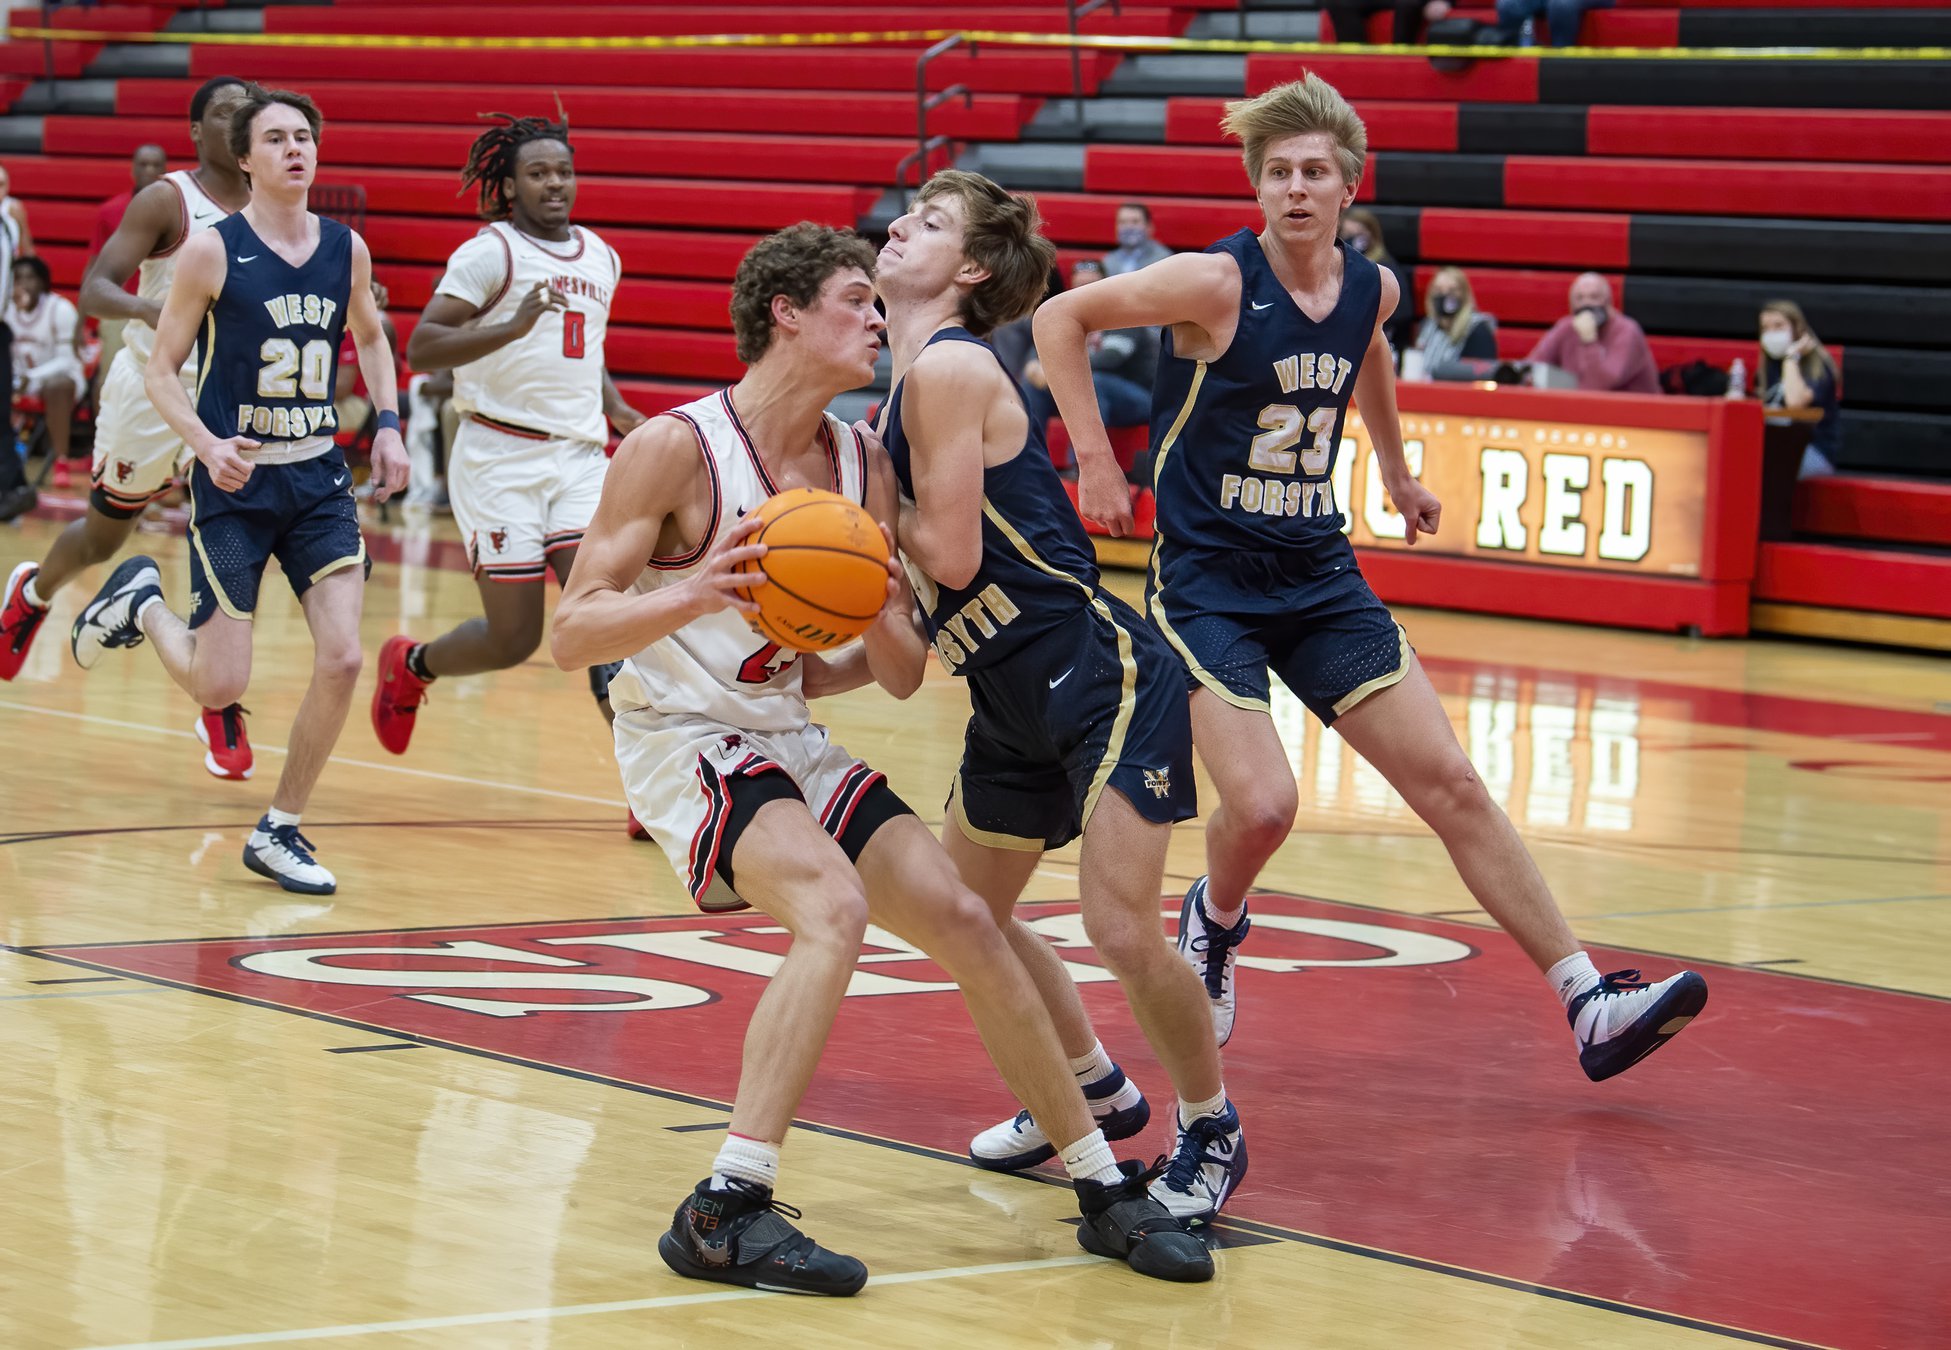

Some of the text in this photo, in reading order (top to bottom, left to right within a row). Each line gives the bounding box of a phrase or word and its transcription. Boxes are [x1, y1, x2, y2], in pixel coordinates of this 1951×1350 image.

[264, 294, 337, 330] WEST
[562, 310, 585, 359] 0
[257, 338, 332, 400] 20
[1272, 352, 1352, 395] WEST
[1248, 403, 1338, 476] 23
[1475, 446, 1655, 563] RED
[930, 583, 1022, 676] SYTH
